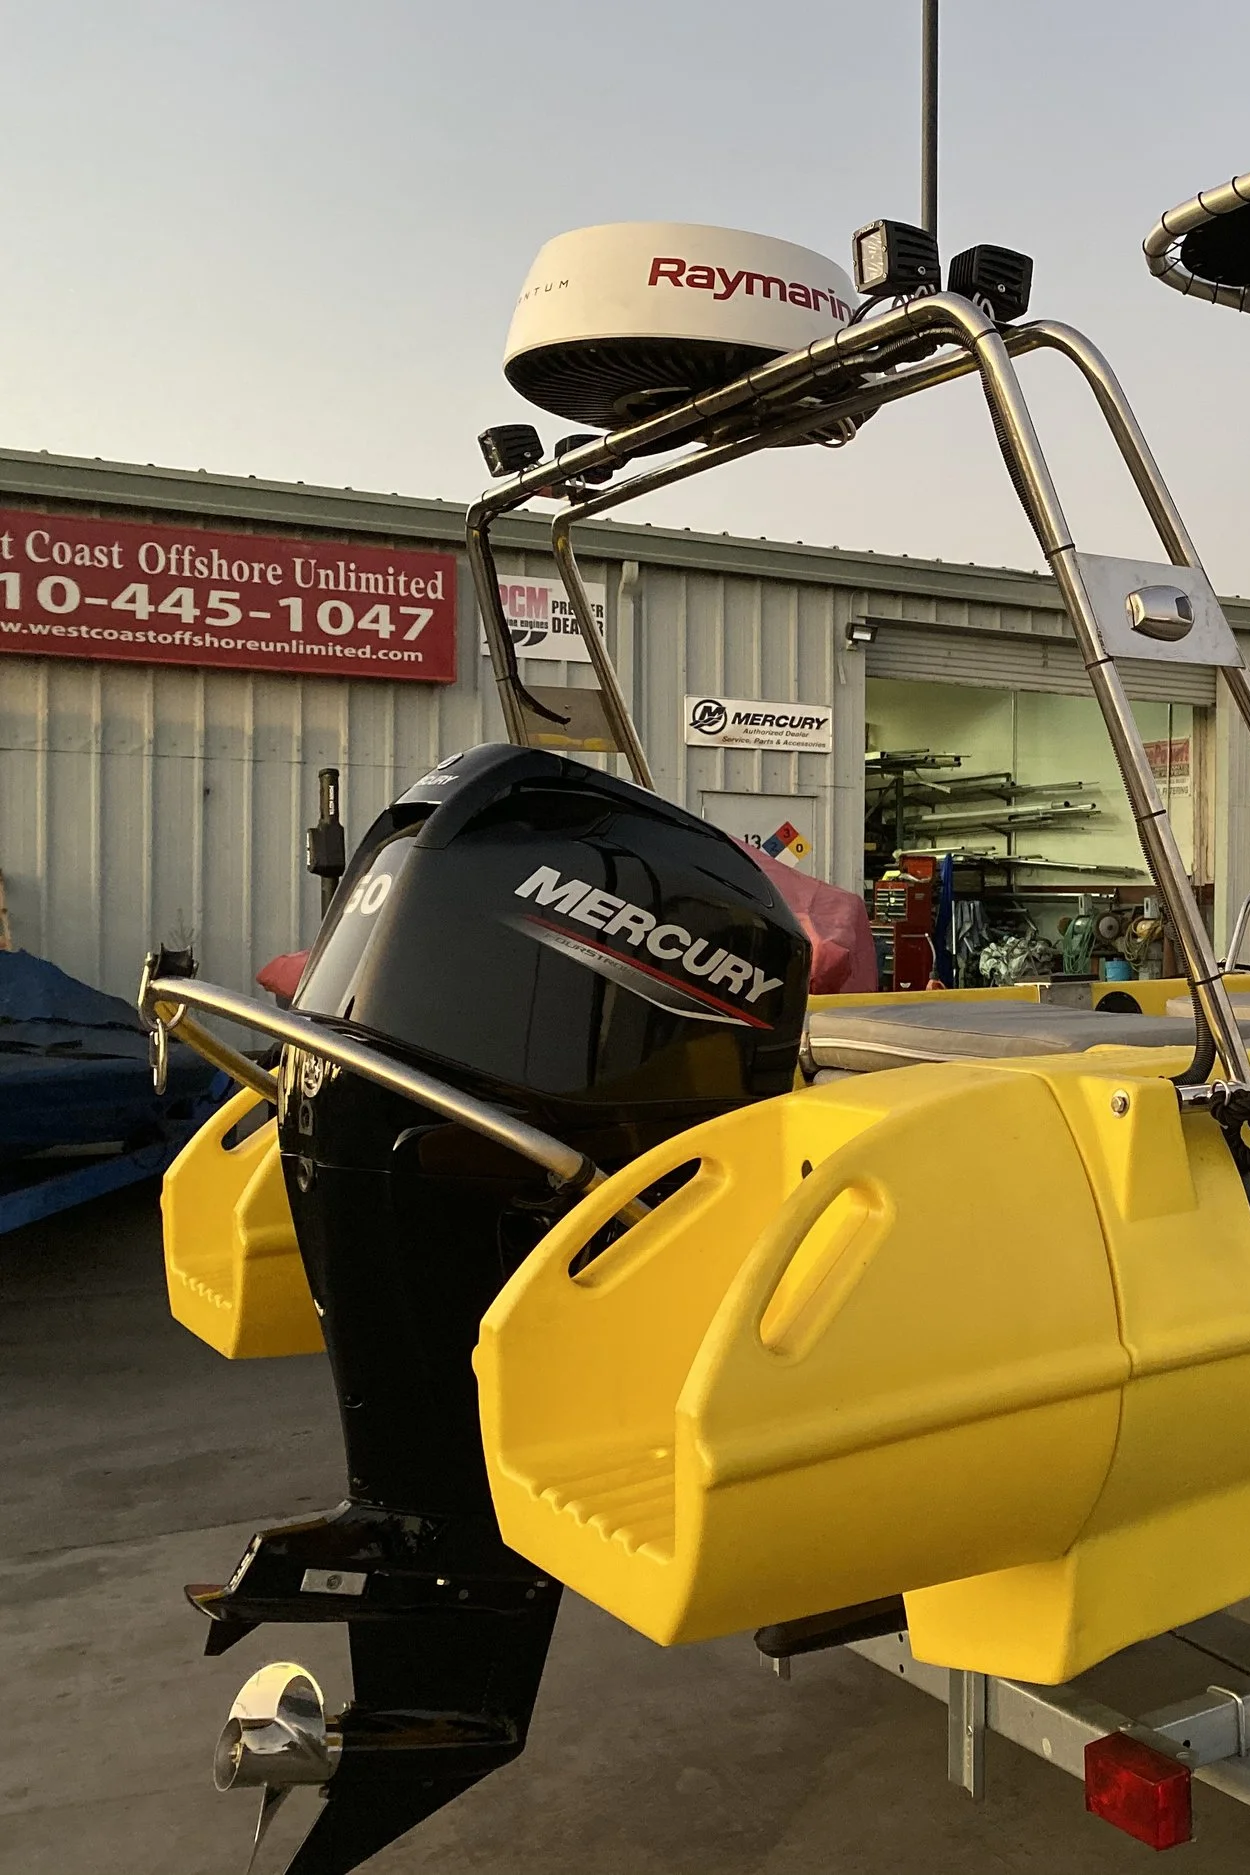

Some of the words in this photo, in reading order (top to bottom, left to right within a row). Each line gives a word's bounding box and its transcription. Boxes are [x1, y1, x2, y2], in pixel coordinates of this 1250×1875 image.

[648, 257, 855, 323] Raymarin
[25, 530, 124, 569] Coast
[138, 541, 283, 585] Offshore
[293, 557, 445, 601] Unlimited
[0, 572, 435, 642] 10-445-1047
[498, 583, 548, 619] PCM
[552, 600, 604, 618] PRER
[520, 619, 549, 630] engines
[552, 616, 604, 637] DEAR
[0, 619, 424, 663] w.westcoastoffshoreunlimited.com
[731, 712, 829, 731] MERCURY
[722, 735, 752, 744] Service,
[754, 737, 774, 745] Parts
[783, 739, 826, 748] Accessories
[743, 728, 784, 737] Authorized
[785, 730, 810, 738] Dealer
[783, 828, 791, 839] 3
[795, 843, 804, 853] 0
[514, 865, 784, 1003] MERCURY
